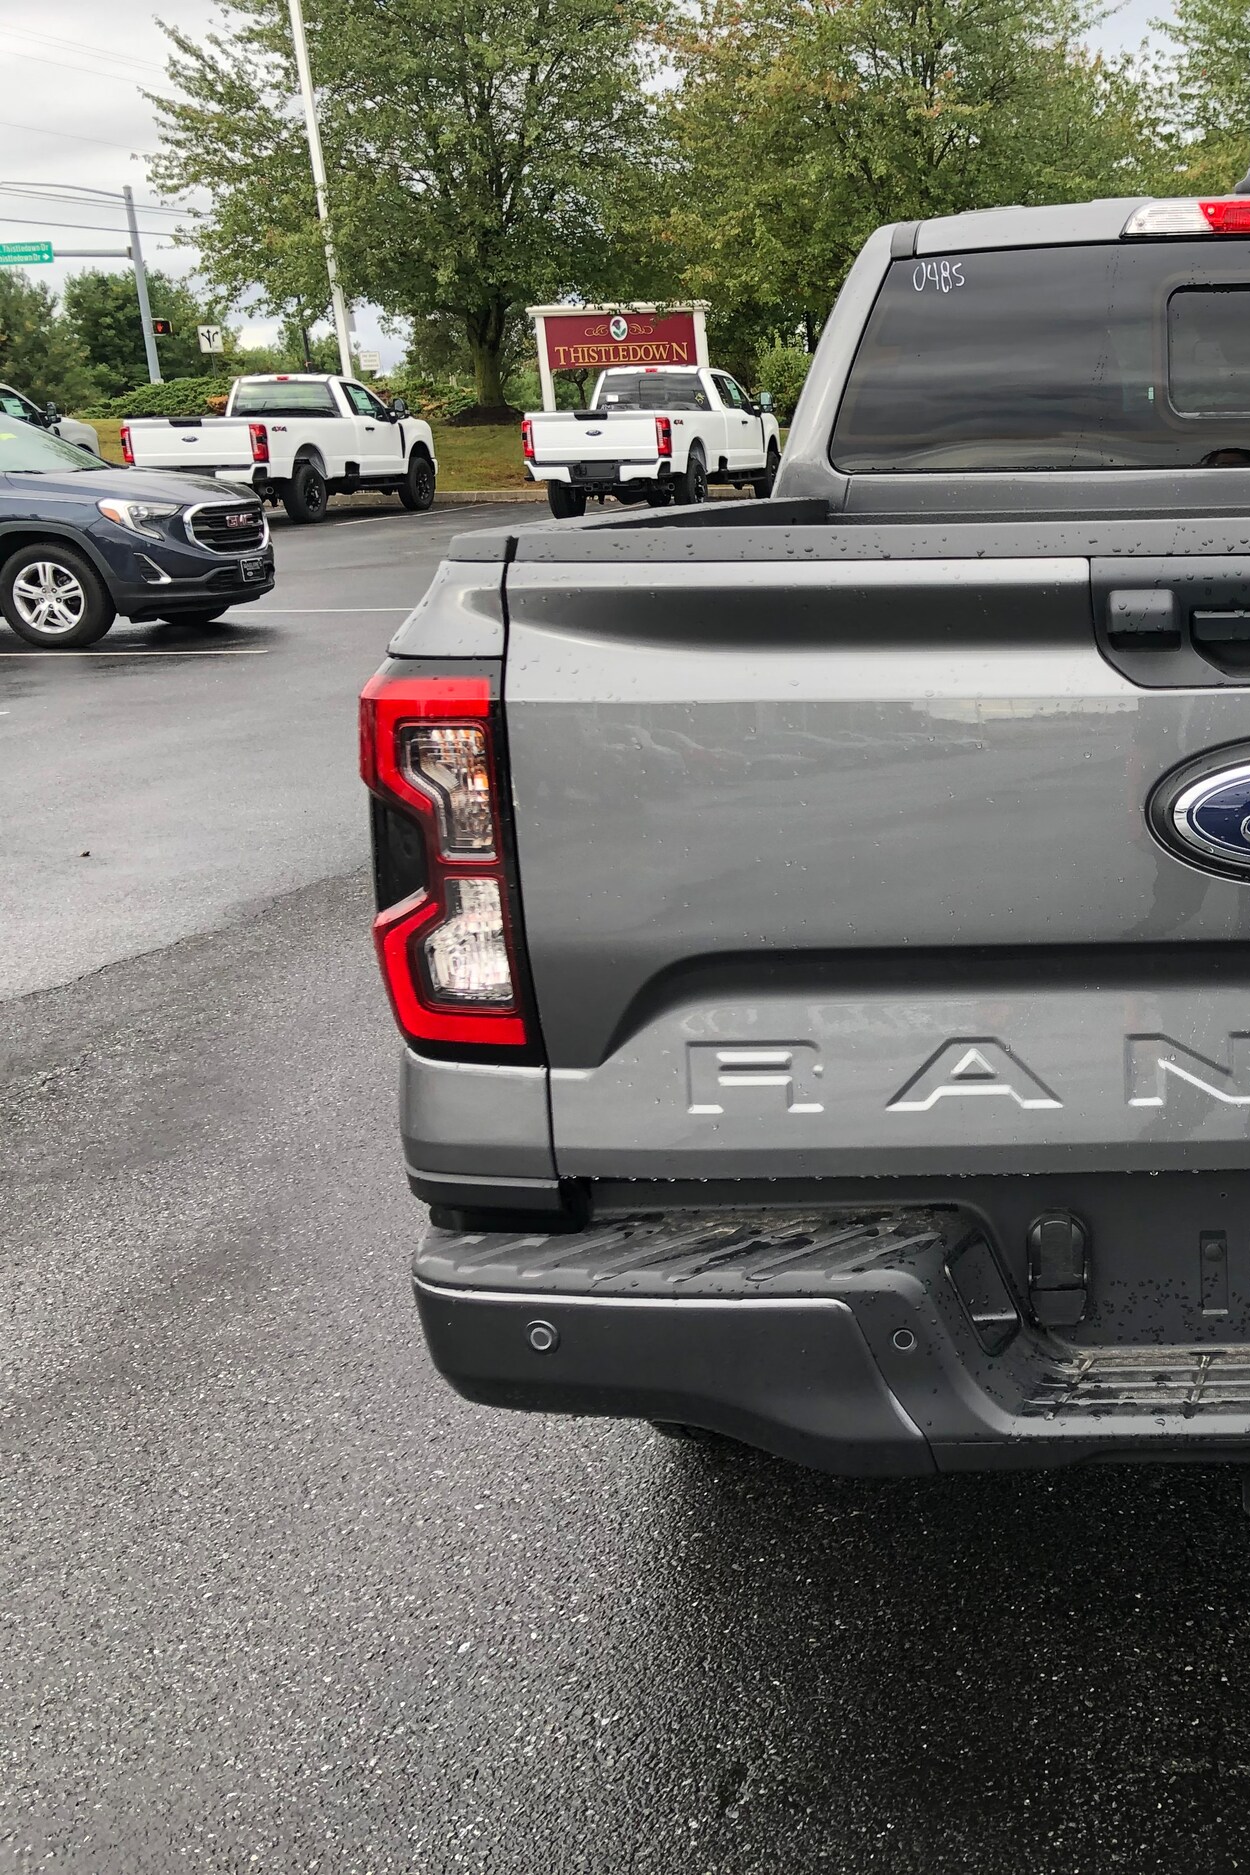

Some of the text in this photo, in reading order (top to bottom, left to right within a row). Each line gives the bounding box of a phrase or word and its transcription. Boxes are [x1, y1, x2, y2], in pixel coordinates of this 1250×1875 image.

[0, 254, 32, 262] histledown
[913, 261, 965, 293] 0485
[554, 342, 688, 366] THISTLEDOWN
[226, 513, 253, 528] GMC
